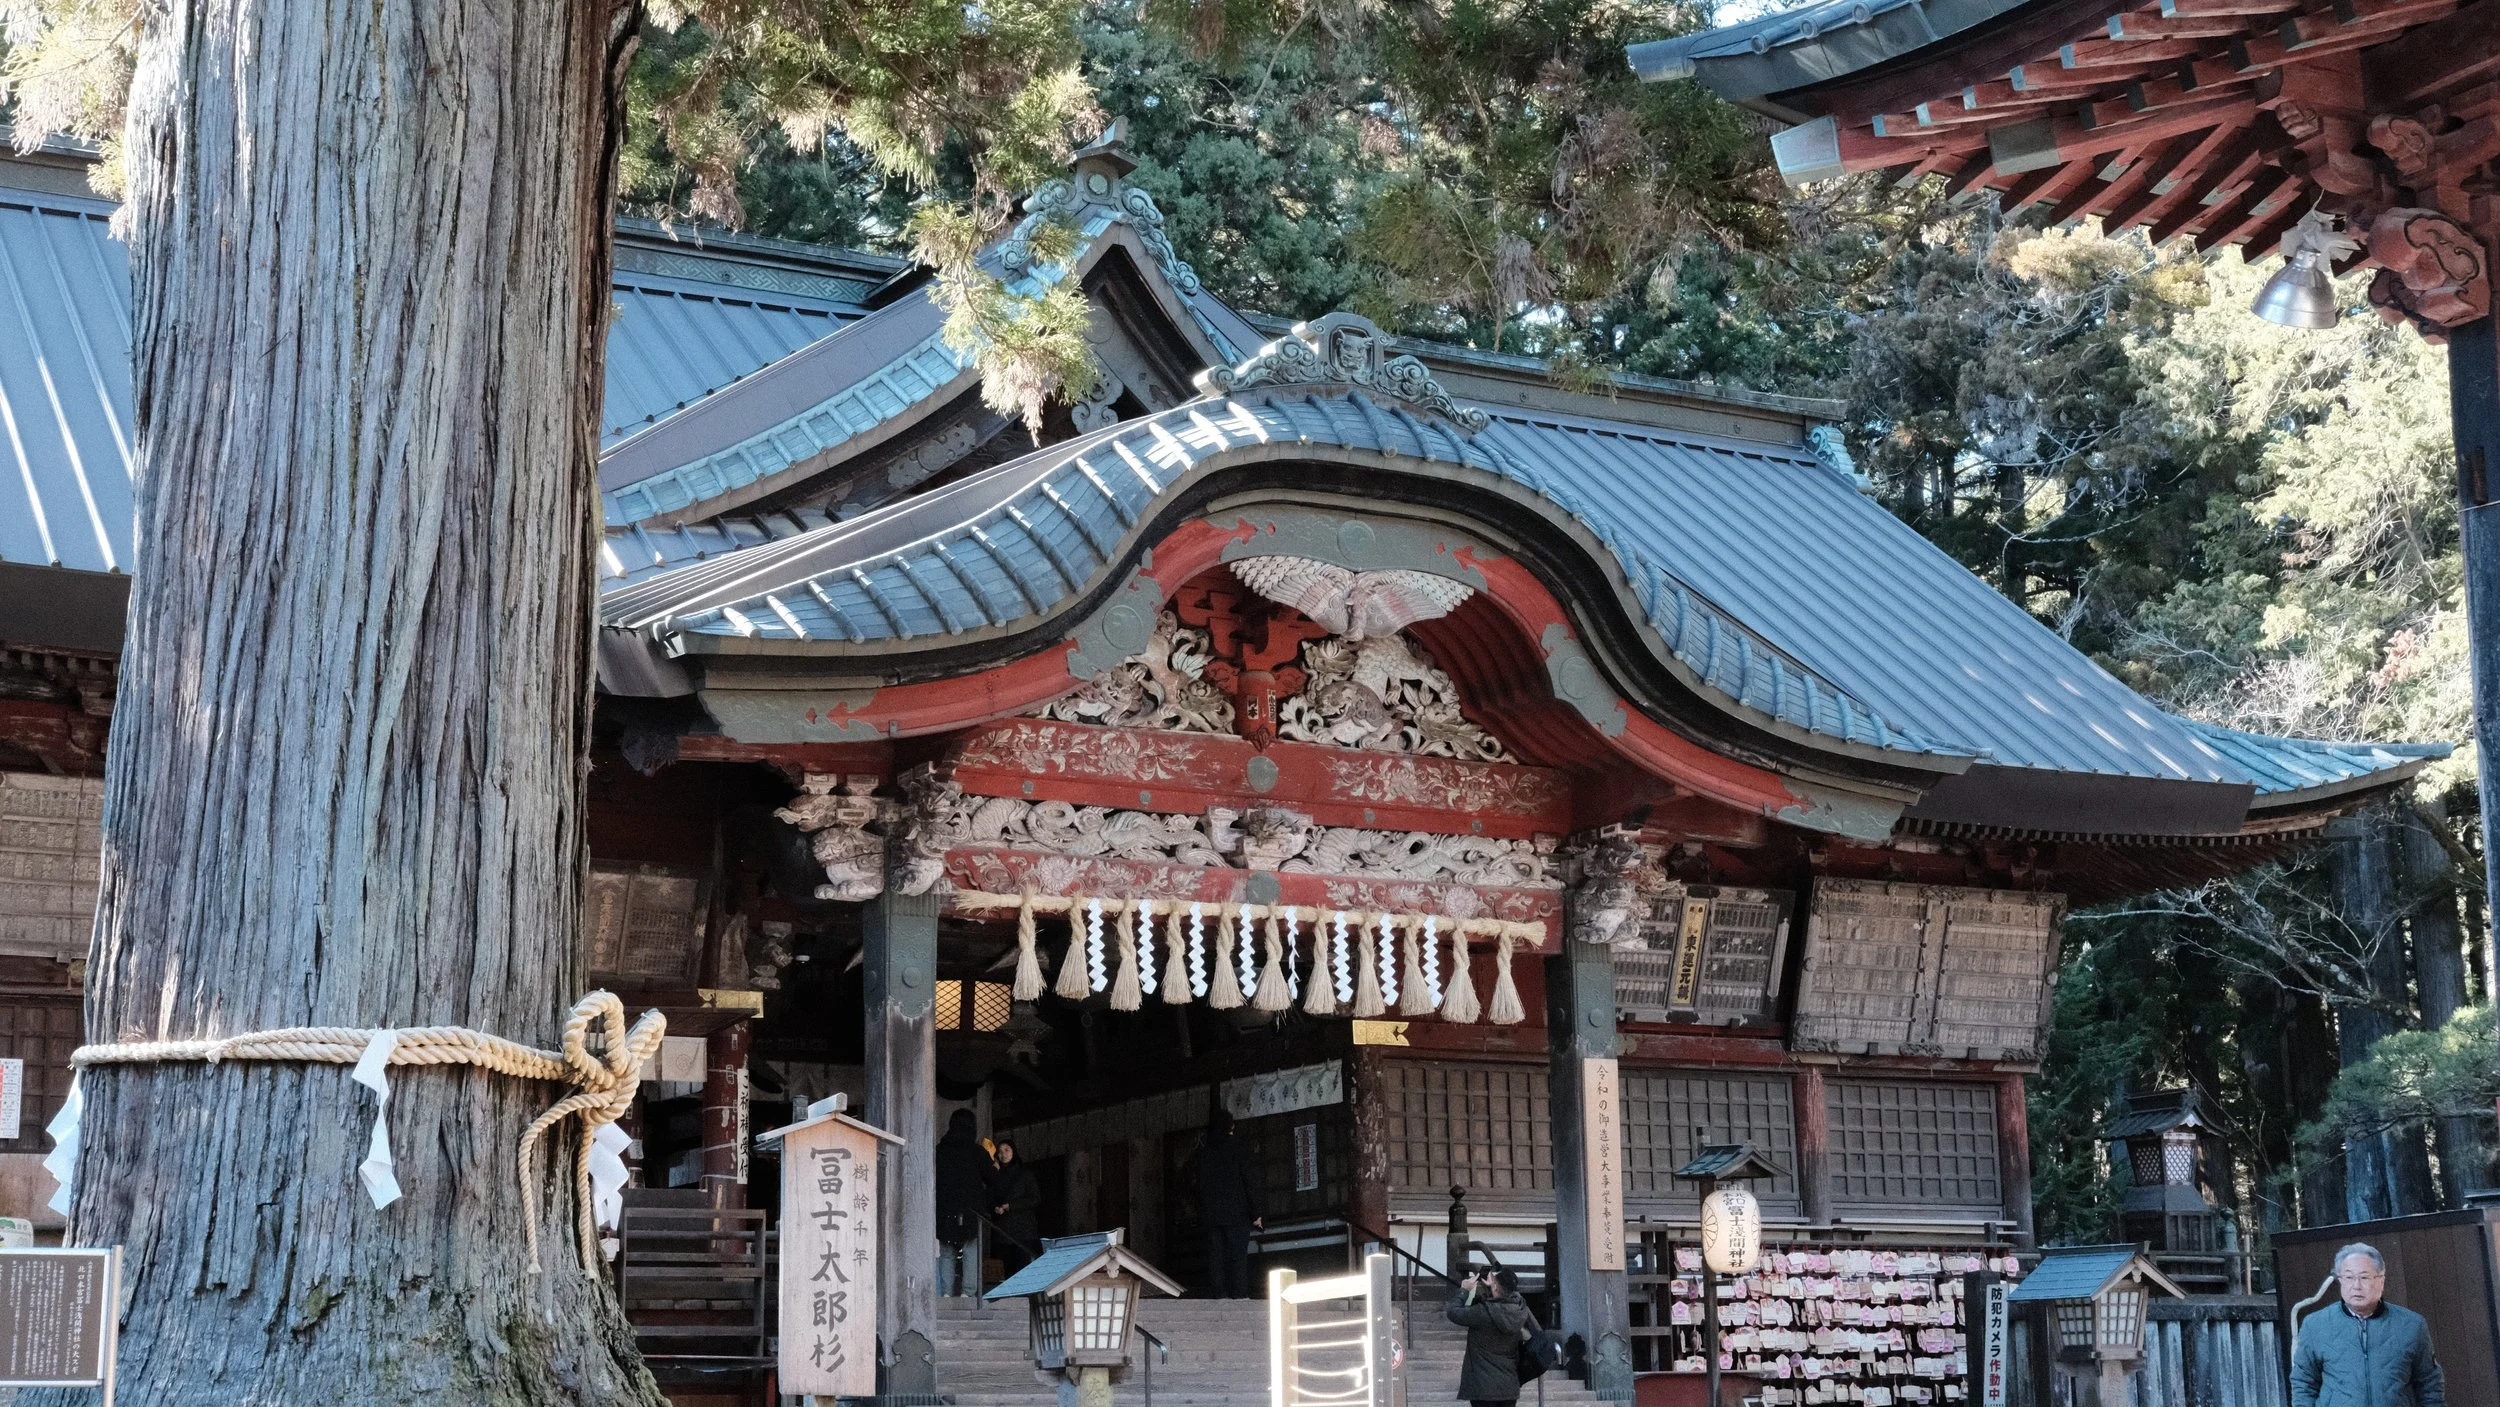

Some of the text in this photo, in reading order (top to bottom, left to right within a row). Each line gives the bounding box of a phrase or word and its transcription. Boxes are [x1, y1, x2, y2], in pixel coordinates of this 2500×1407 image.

[1989, 1288, 2002, 1400] 防犯カメラ作動中
